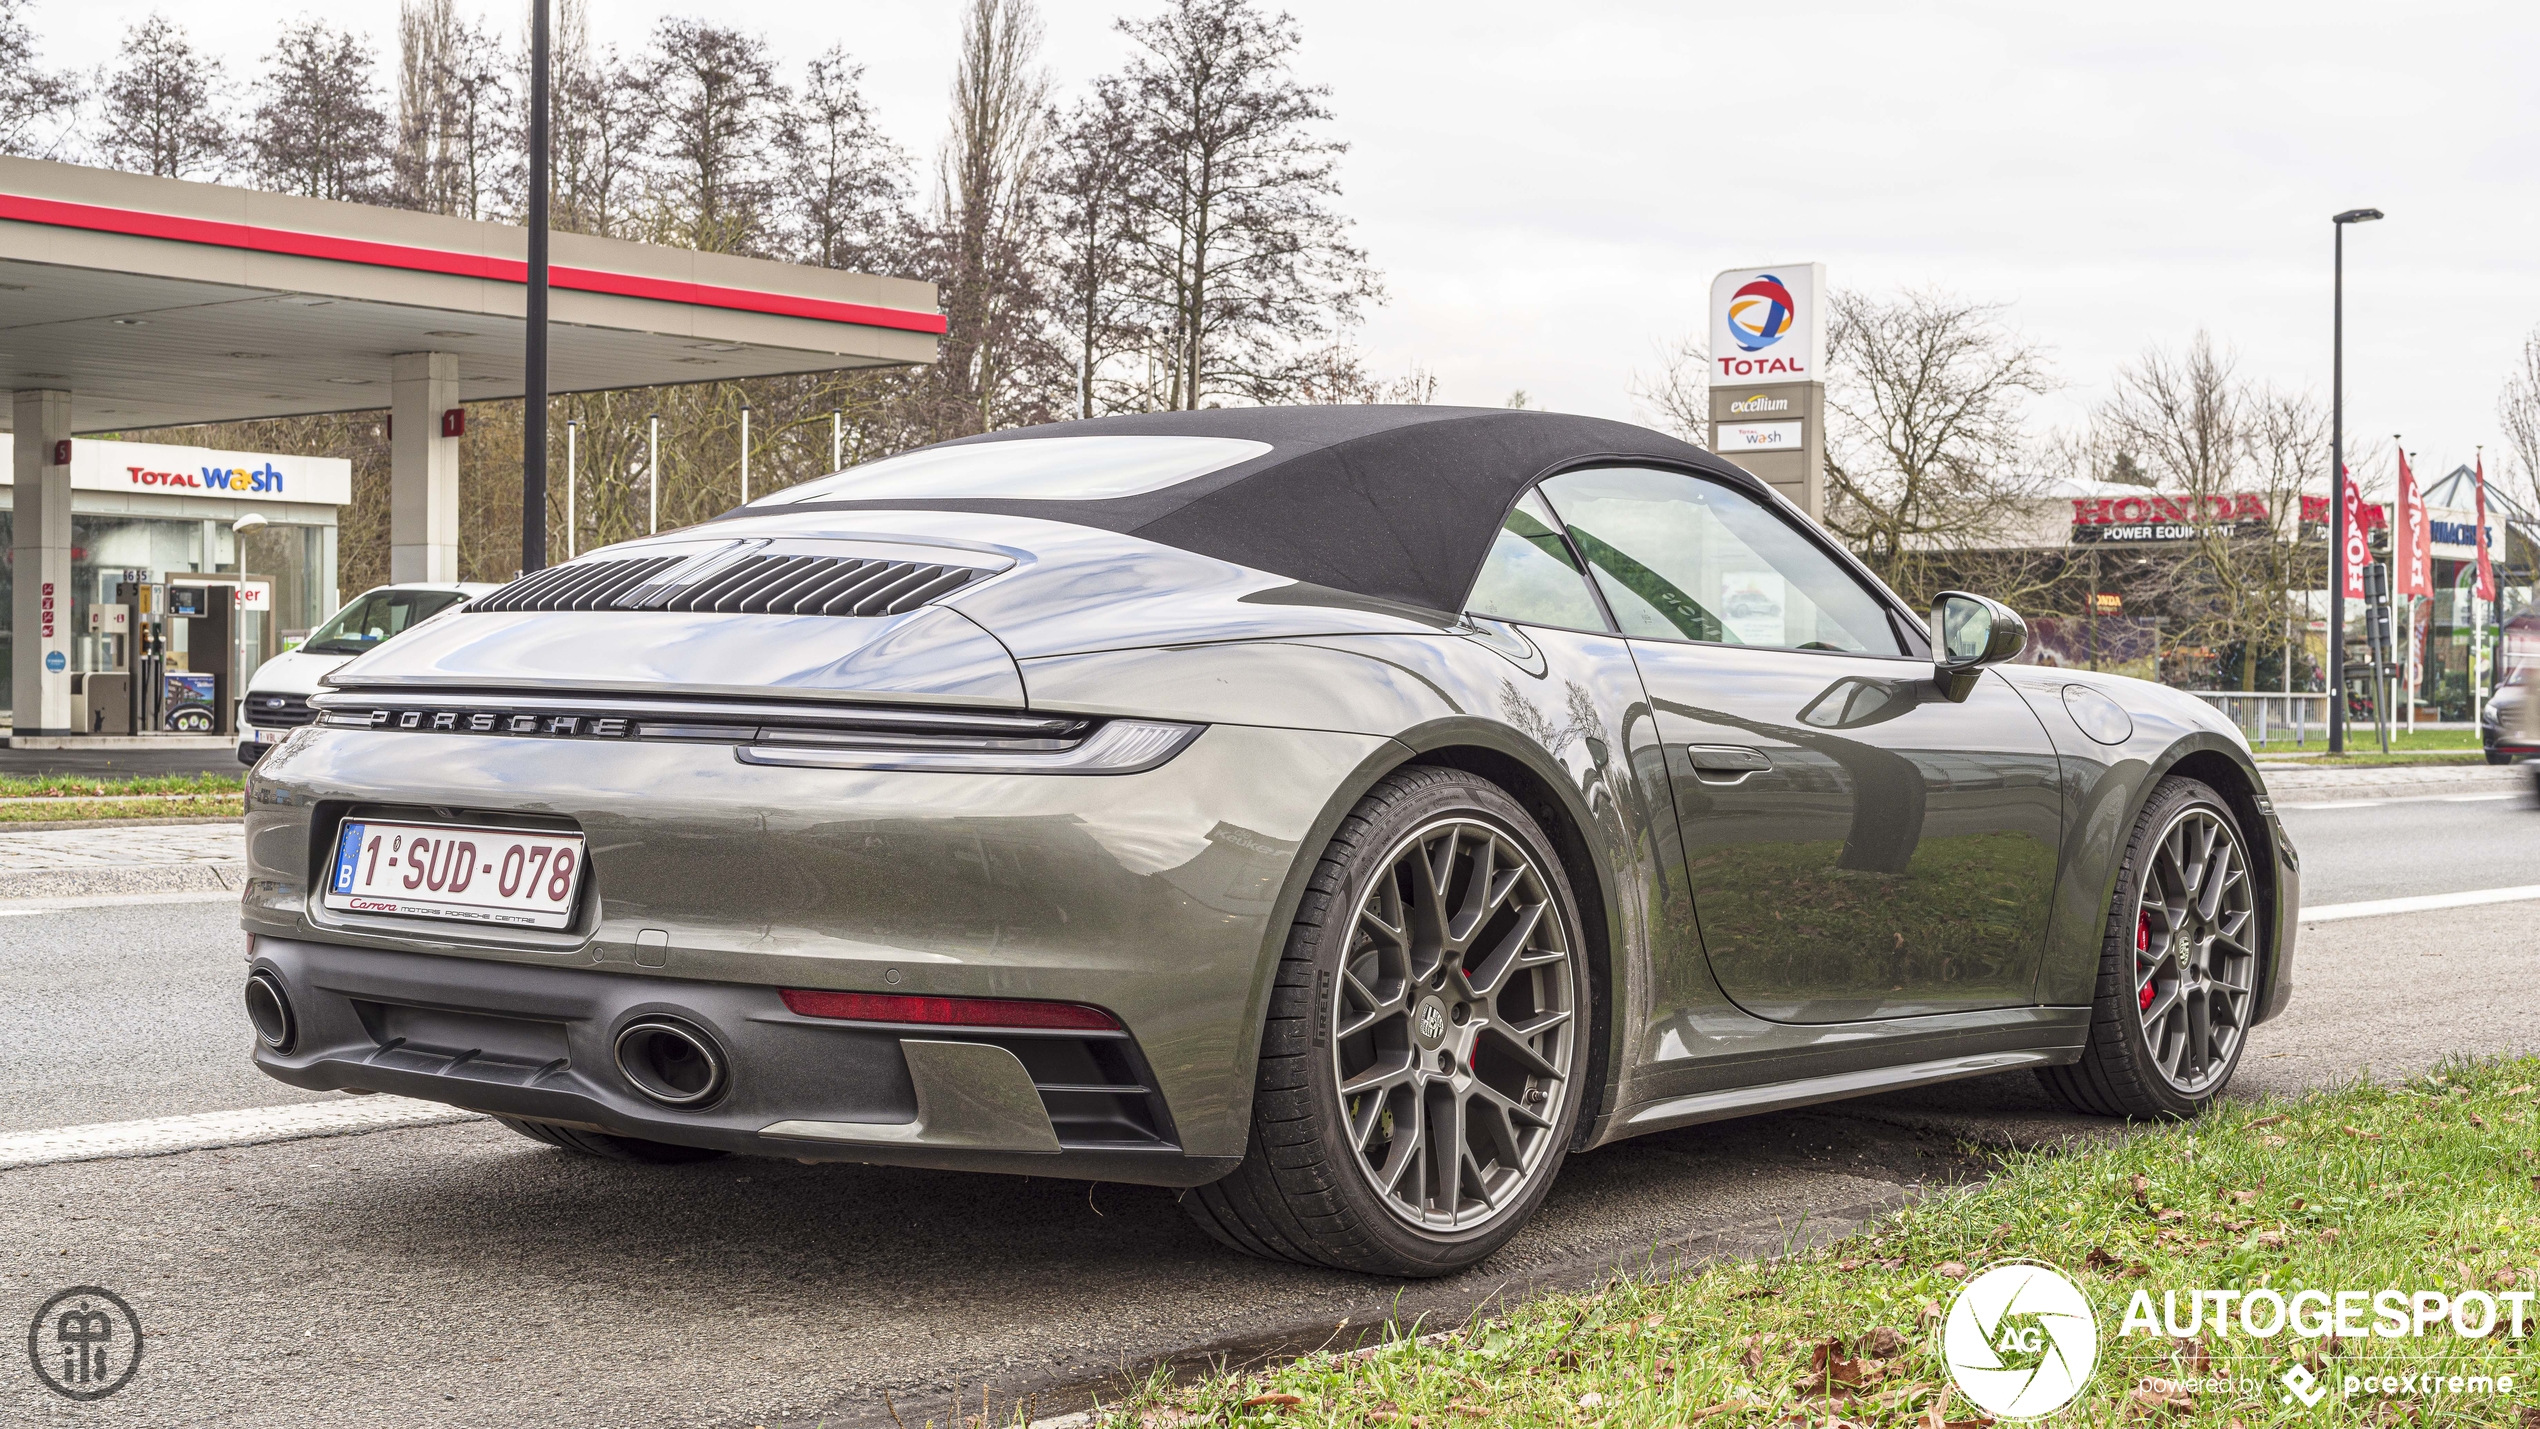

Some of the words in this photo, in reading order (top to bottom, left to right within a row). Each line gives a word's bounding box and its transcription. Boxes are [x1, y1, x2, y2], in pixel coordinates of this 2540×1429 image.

[1718, 357, 1804, 376] TOTAL
[1730, 396, 1789, 413] excellium
[448, 414, 455, 431] 1
[1746, 430, 1782, 444] wash
[60, 445, 66, 460] 5
[127, 466, 201, 488] TOTAL
[2072, 494, 2270, 524] HONDA
[2104, 526, 2151, 540] POWER
[2156, 524, 2237, 539] EQUIPENT
[369, 710, 629, 738] PORSCHE
[338, 864, 353, 889] B
[365, 835, 575, 901] 1-SUD-078
[349, 897, 398, 912] Carrera
[400, 906, 441, 915] MOTORS
[445, 910, 491, 920] PORSCHE
[495, 914, 536, 924] CENTRE
[1312, 969, 1331, 1048] PIRELLI
